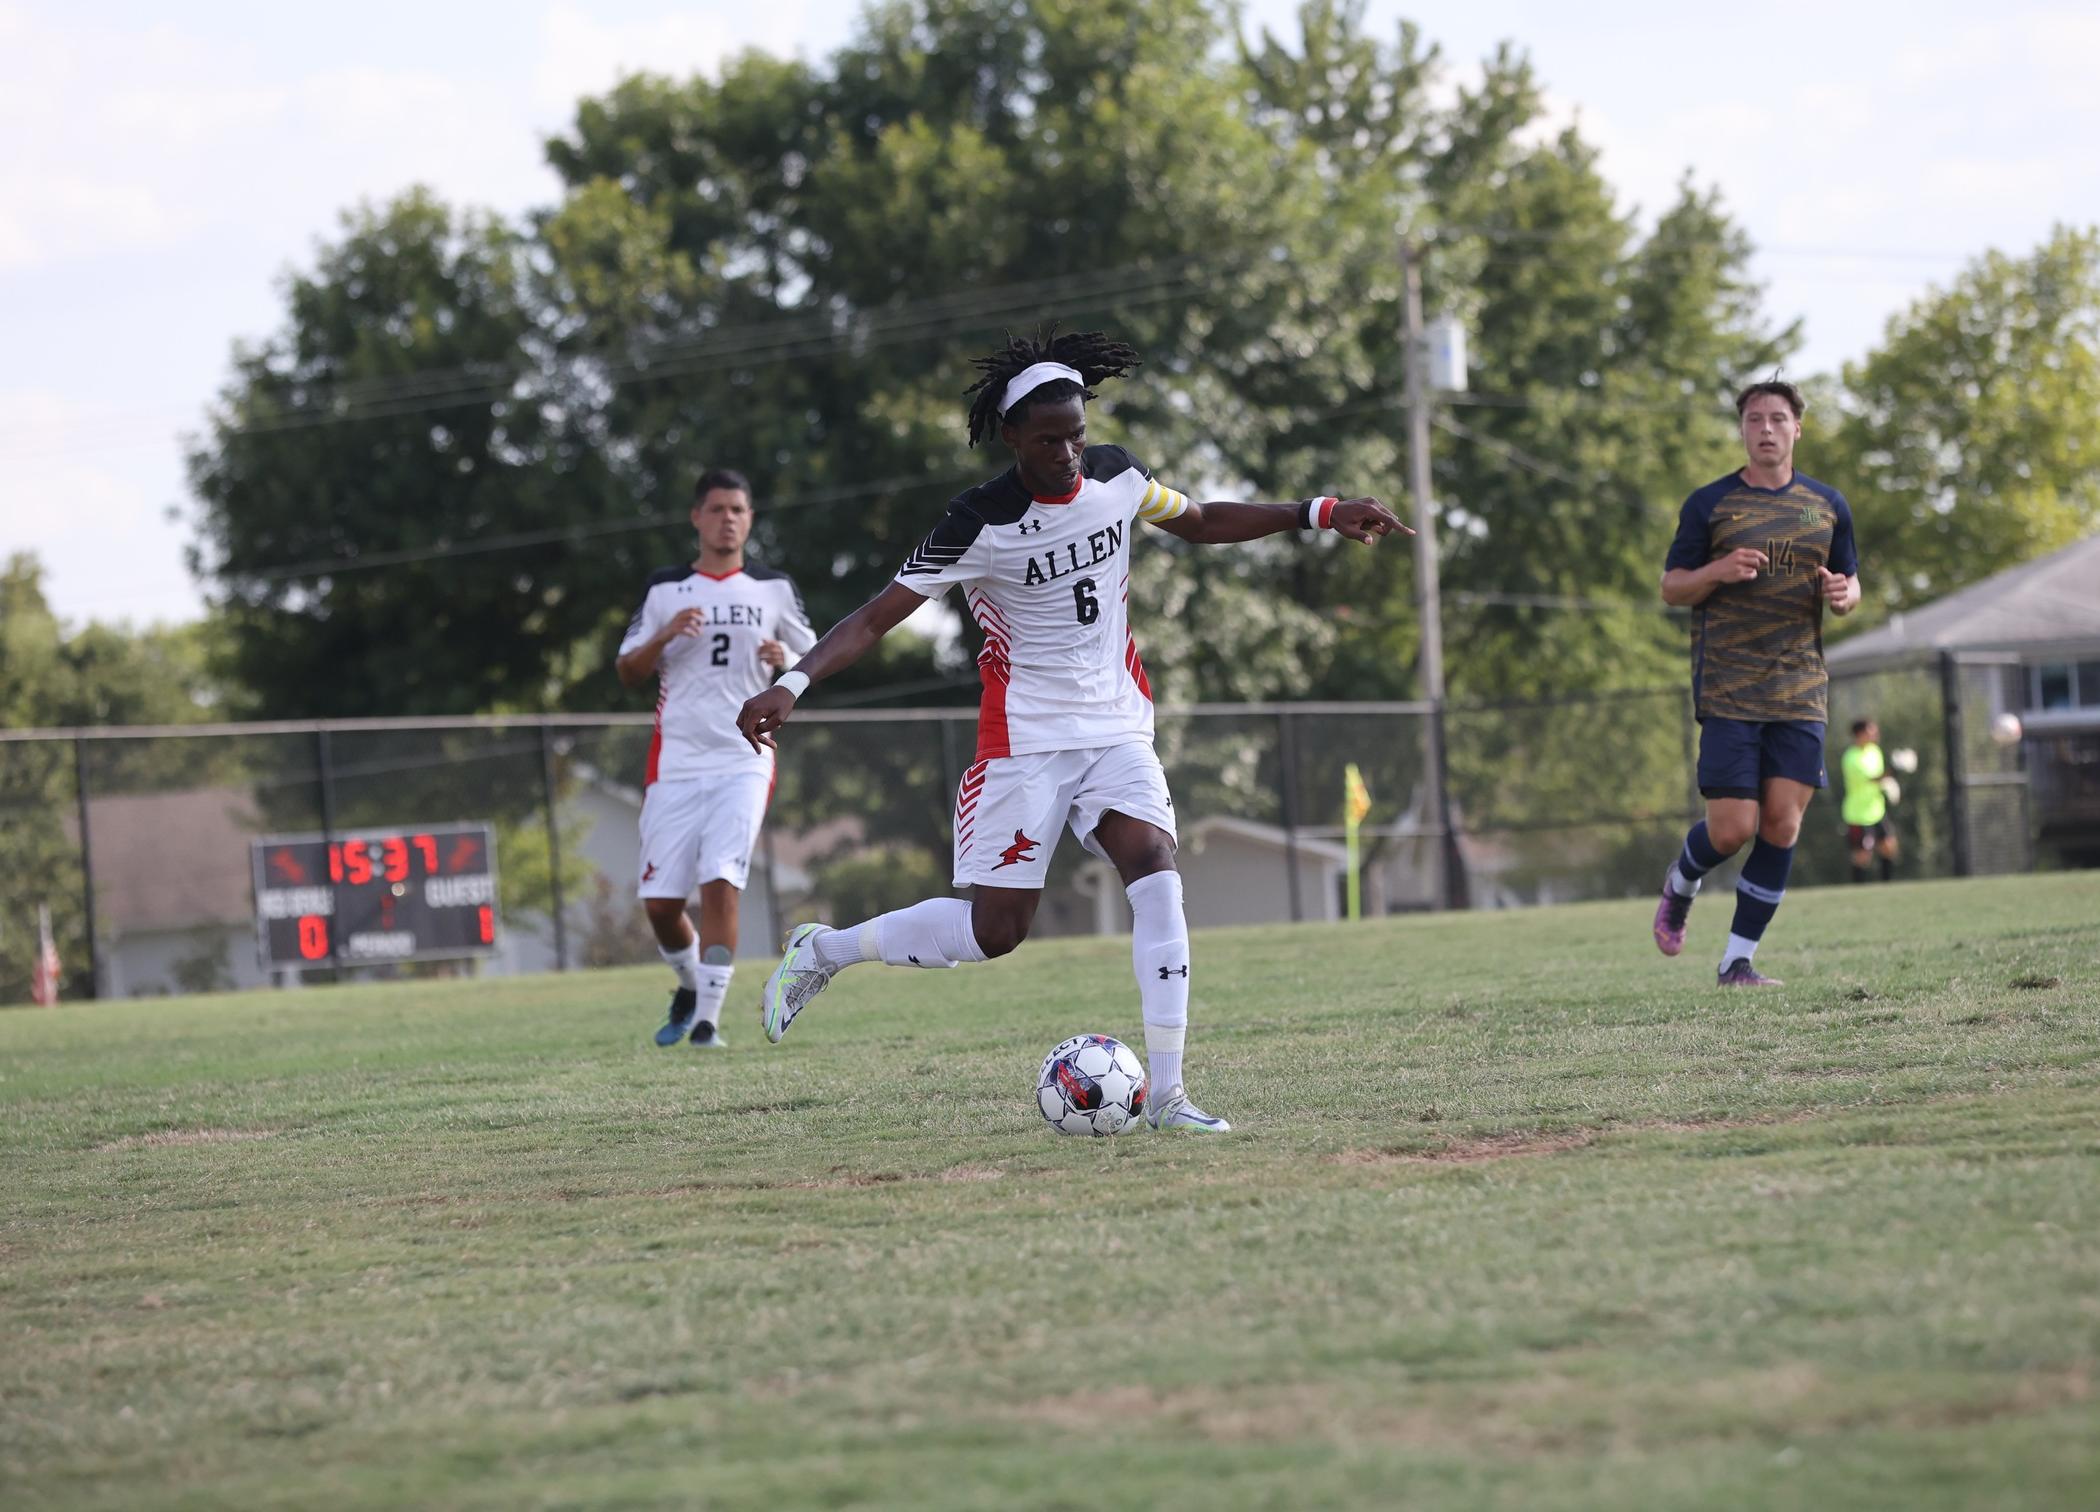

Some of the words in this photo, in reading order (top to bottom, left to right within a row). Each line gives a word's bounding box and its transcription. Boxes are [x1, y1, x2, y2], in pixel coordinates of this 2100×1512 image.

[1023, 519, 1123, 586] ALLEN
[1767, 537, 1795, 577] 14
[703, 603, 762, 627] LEN
[1072, 577, 1100, 626] 6
[711, 632, 730, 667] 2
[424, 874, 495, 908] GUEST
[298, 914, 329, 960] 0
[478, 904, 494, 945] 1
